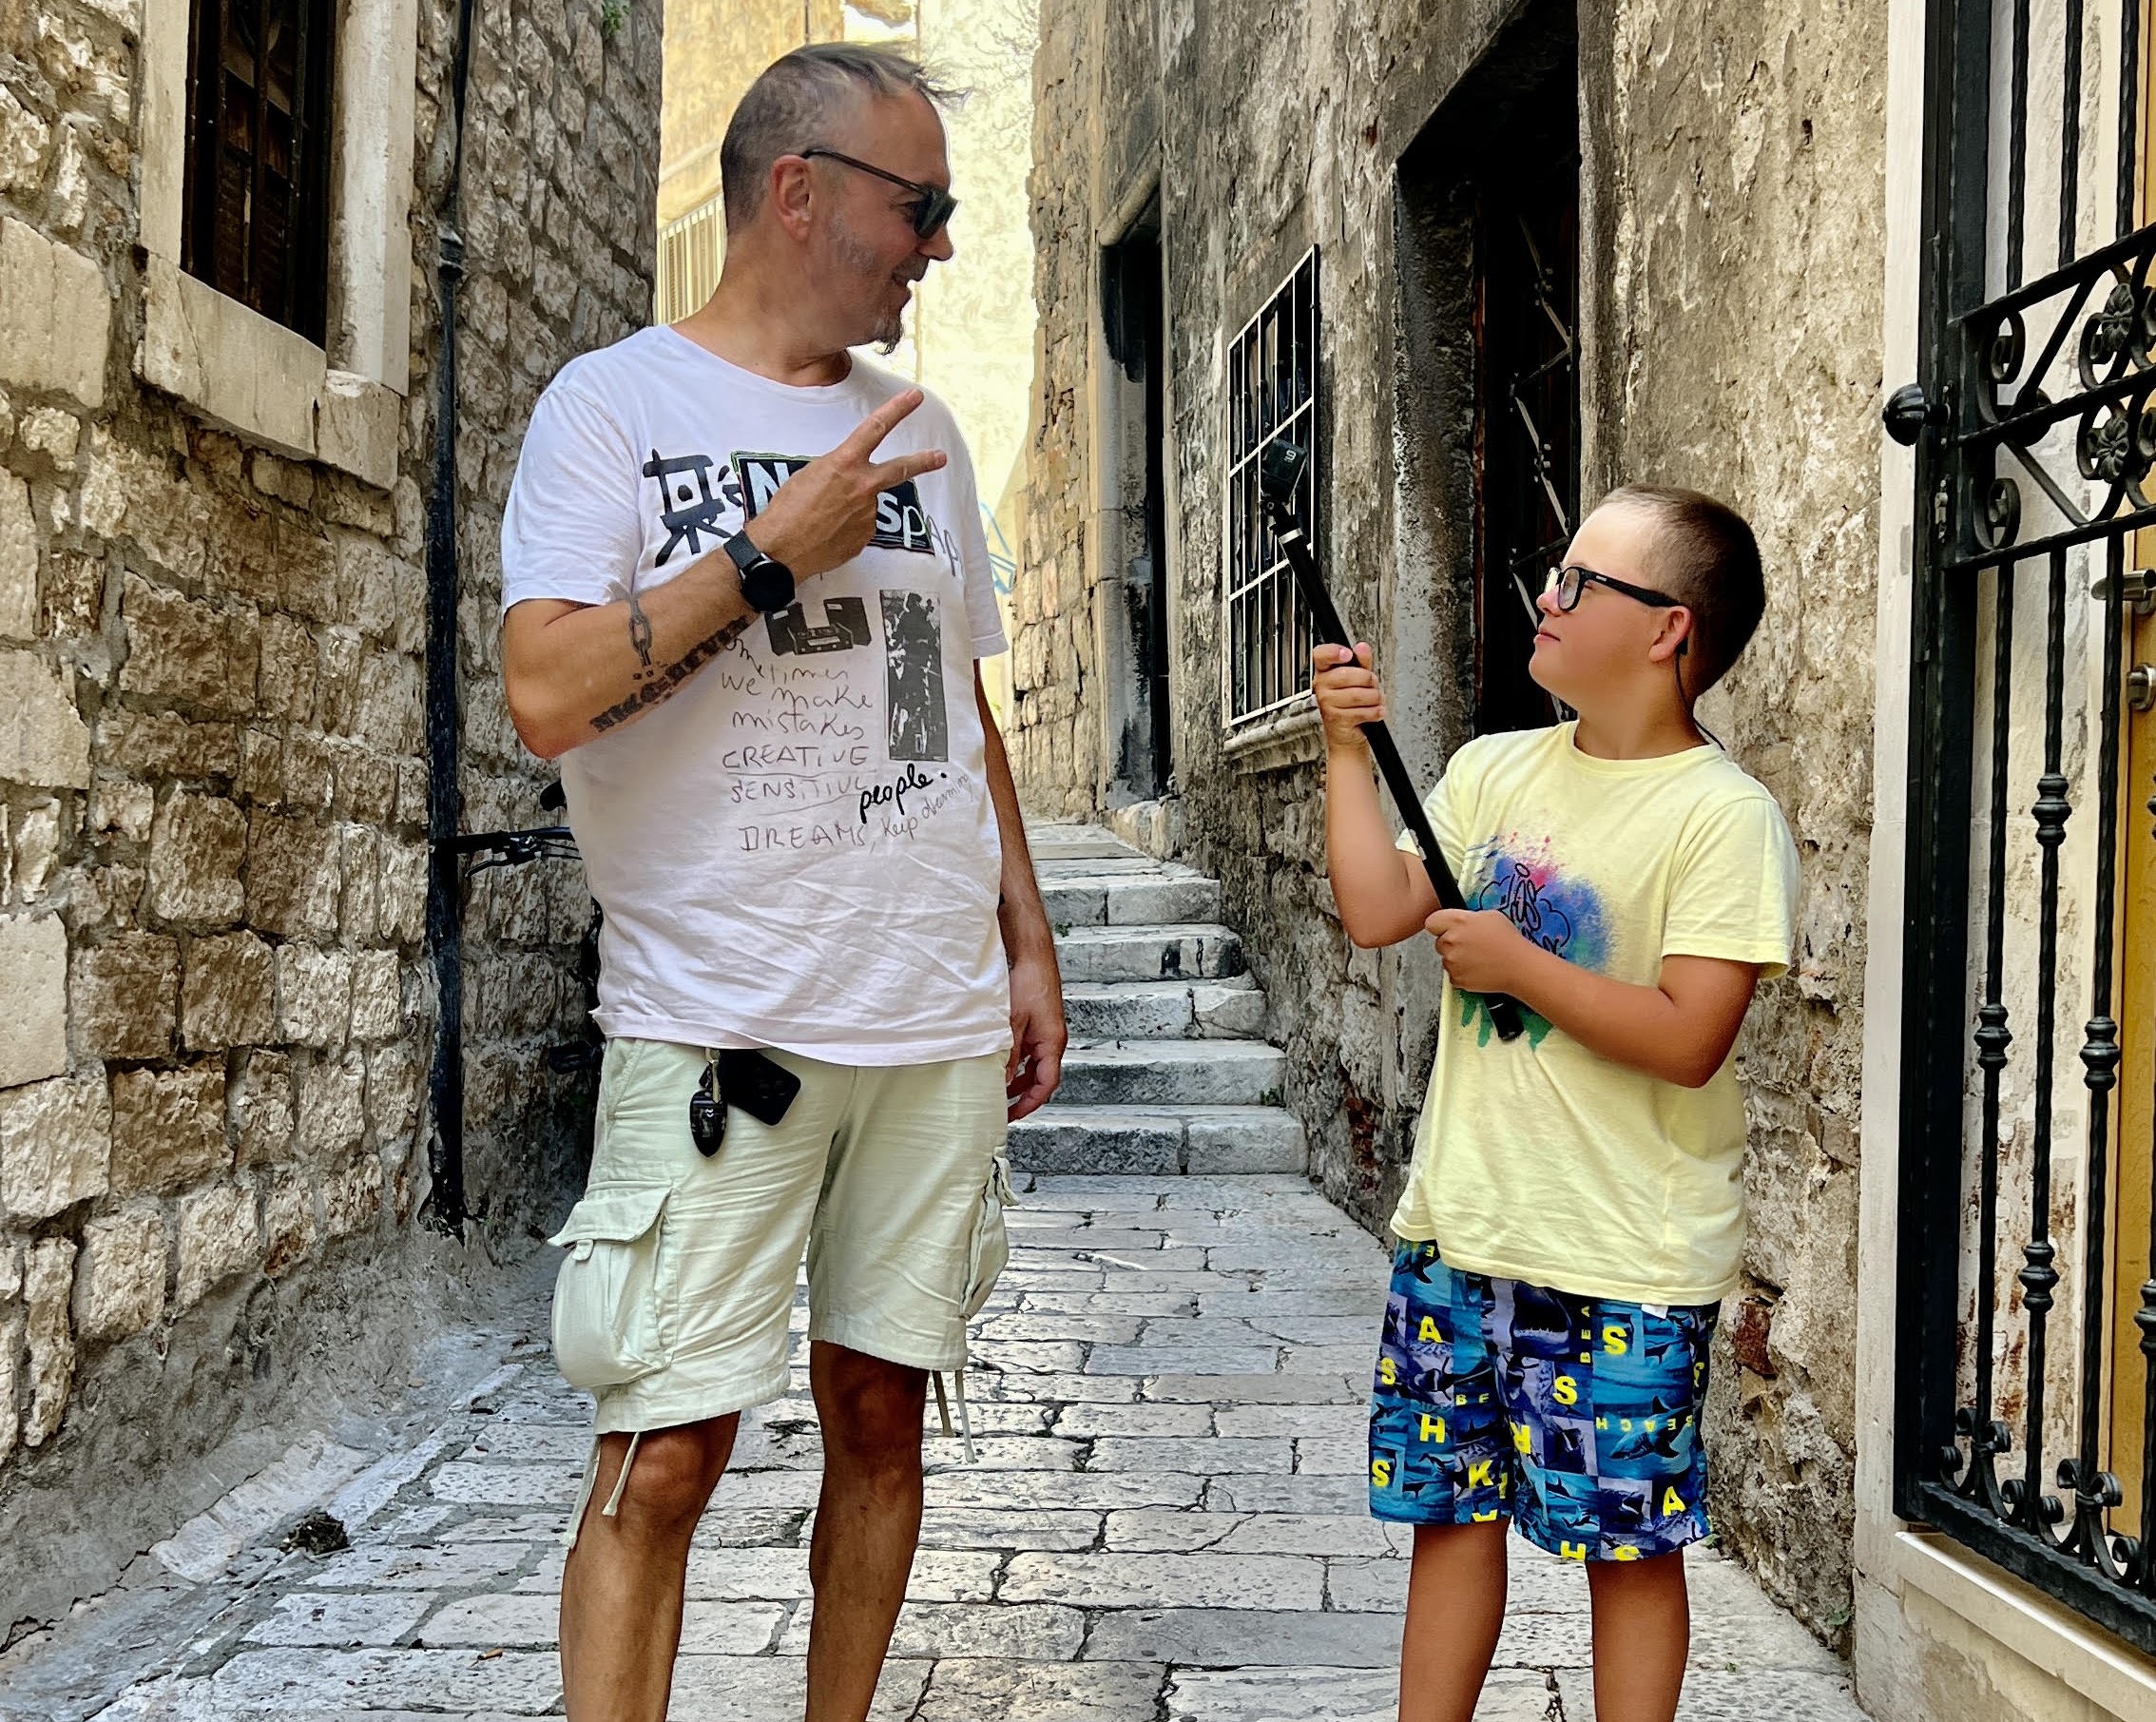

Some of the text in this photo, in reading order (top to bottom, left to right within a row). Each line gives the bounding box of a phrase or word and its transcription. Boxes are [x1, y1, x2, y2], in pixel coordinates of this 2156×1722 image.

[722, 745, 869, 768] CREATIVE
[1417, 1315, 1444, 1345] A
[1602, 1326, 1627, 1356] S
[1380, 1357, 1396, 1385] S
[1553, 1375, 1578, 1405] S
[1419, 1413, 1446, 1443] H
[1372, 1459, 1391, 1488] S
[1468, 1459, 1494, 1489] K
[1663, 1485, 1686, 1517] A
